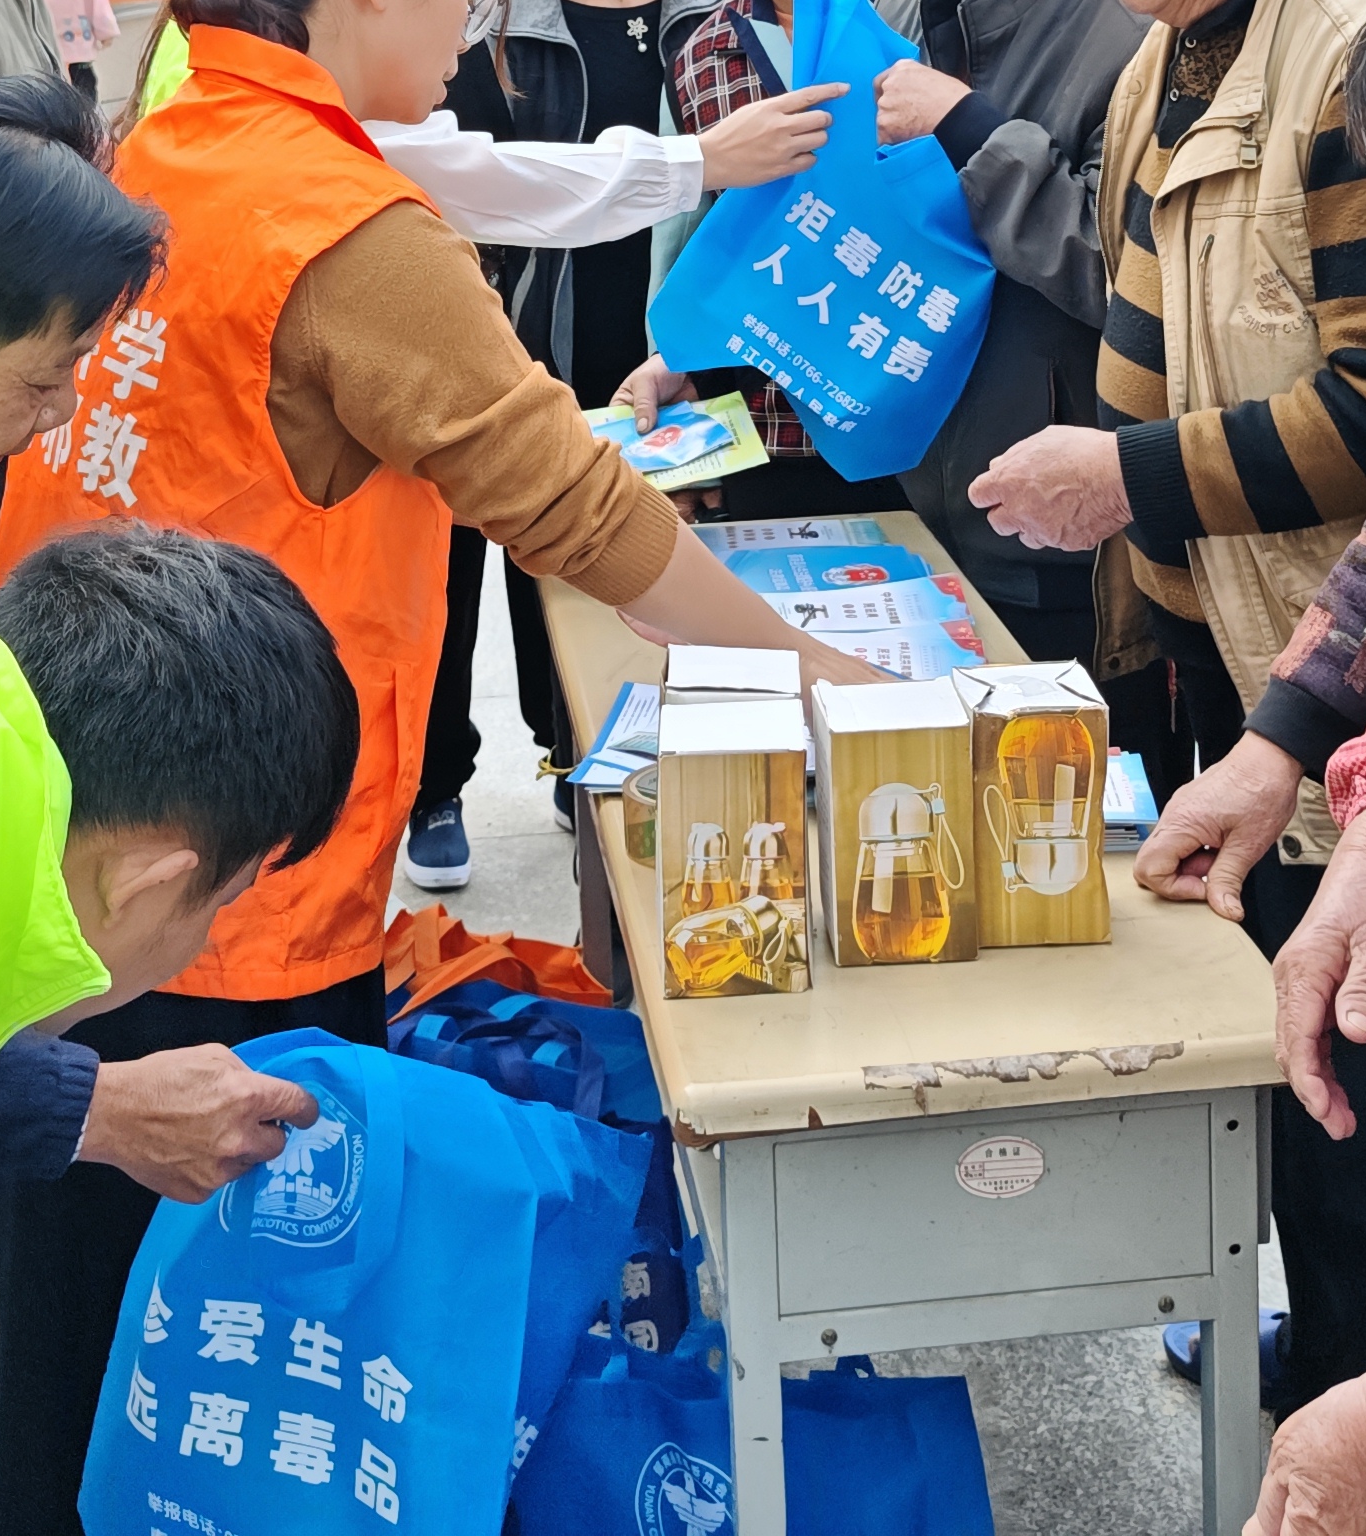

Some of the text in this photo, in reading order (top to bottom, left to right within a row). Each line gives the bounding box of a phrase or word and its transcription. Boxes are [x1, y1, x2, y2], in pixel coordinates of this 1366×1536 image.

[753, 244, 933, 383] 人人有责
[785, 191, 960, 333] 拒毒防毒
[78, 308, 167, 400] 学
